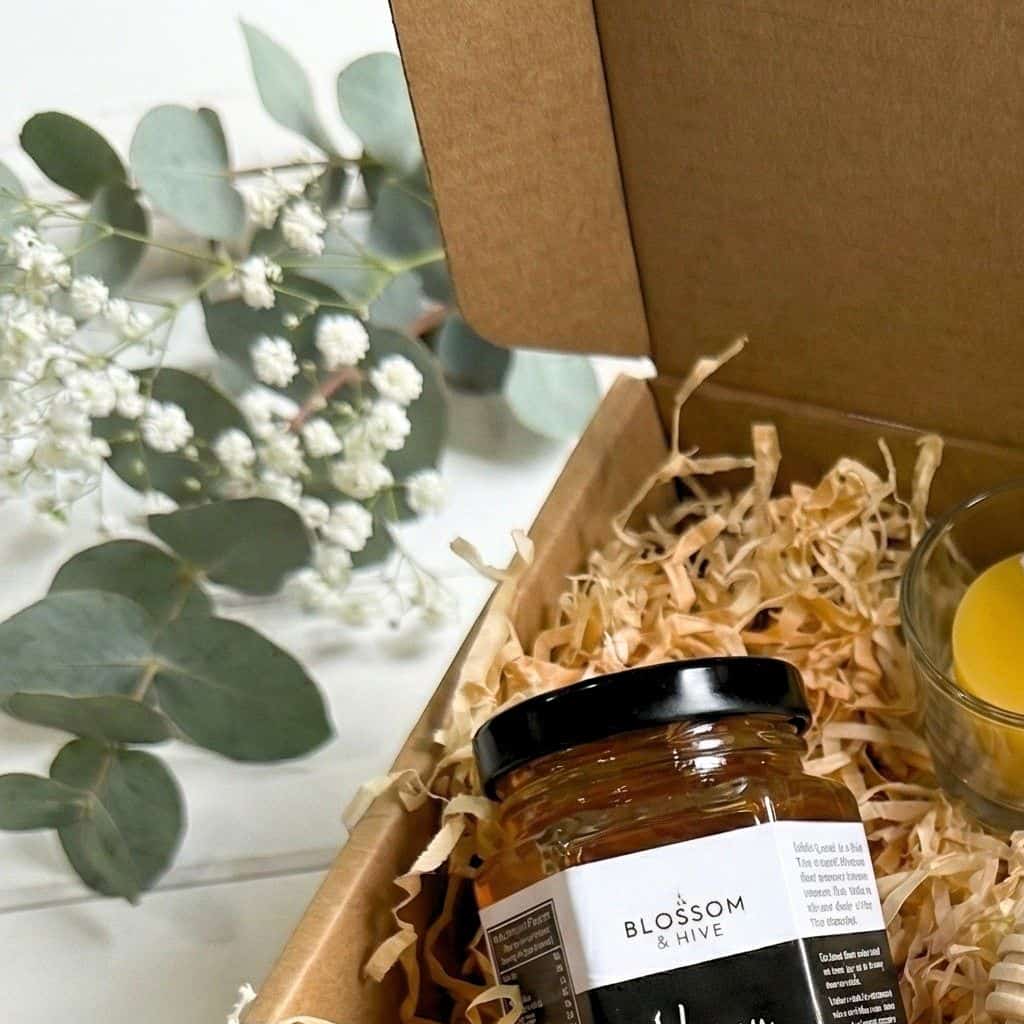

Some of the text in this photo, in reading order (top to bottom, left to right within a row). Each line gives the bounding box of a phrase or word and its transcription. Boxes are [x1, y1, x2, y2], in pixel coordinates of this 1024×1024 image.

[624, 896, 744, 938] BLOSSOM
[657, 923, 724, 950] & HIVE
